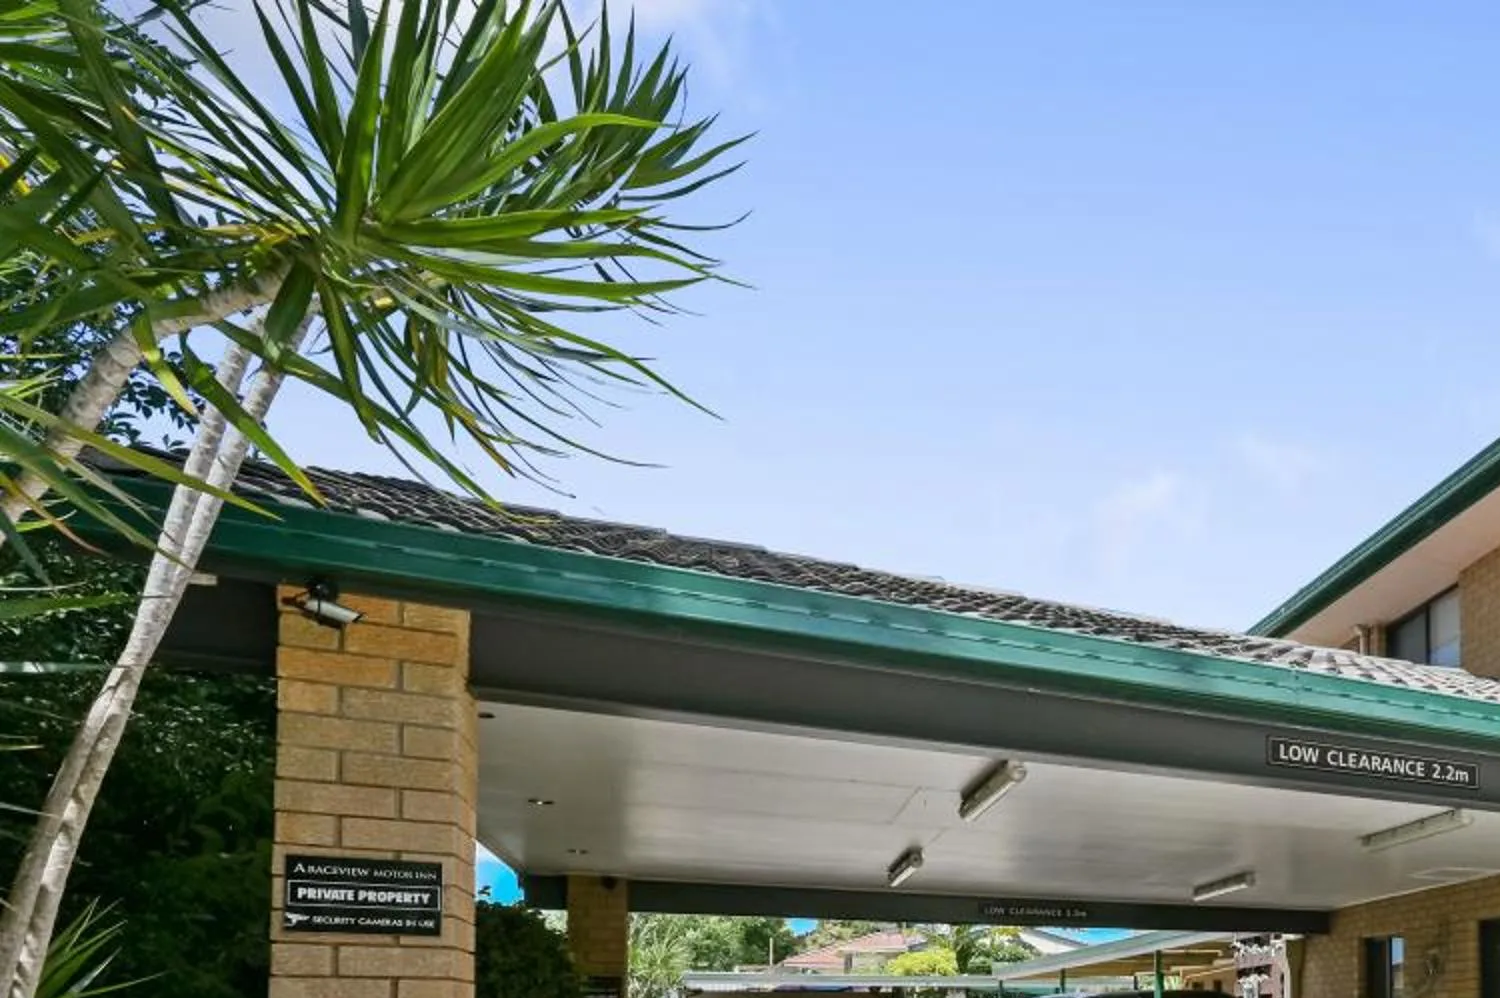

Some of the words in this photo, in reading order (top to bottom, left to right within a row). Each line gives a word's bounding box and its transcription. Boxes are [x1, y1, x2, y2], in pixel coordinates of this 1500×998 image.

[1279, 743, 1319, 764] LOW
[1327, 750, 1425, 777] CLEARANCE
[1432, 763, 1469, 782] 2.2m
[373, 871, 413, 879] MOTOR
[415, 871, 437, 880] INN
[297, 887, 354, 901] PRIVATE
[358, 890, 430, 904] PROPERTY
[312, 915, 355, 925] SECURITY
[358, 917, 402, 927] CAMERAS
[406, 919, 416, 927] IN
[418, 919, 435, 928] USE
